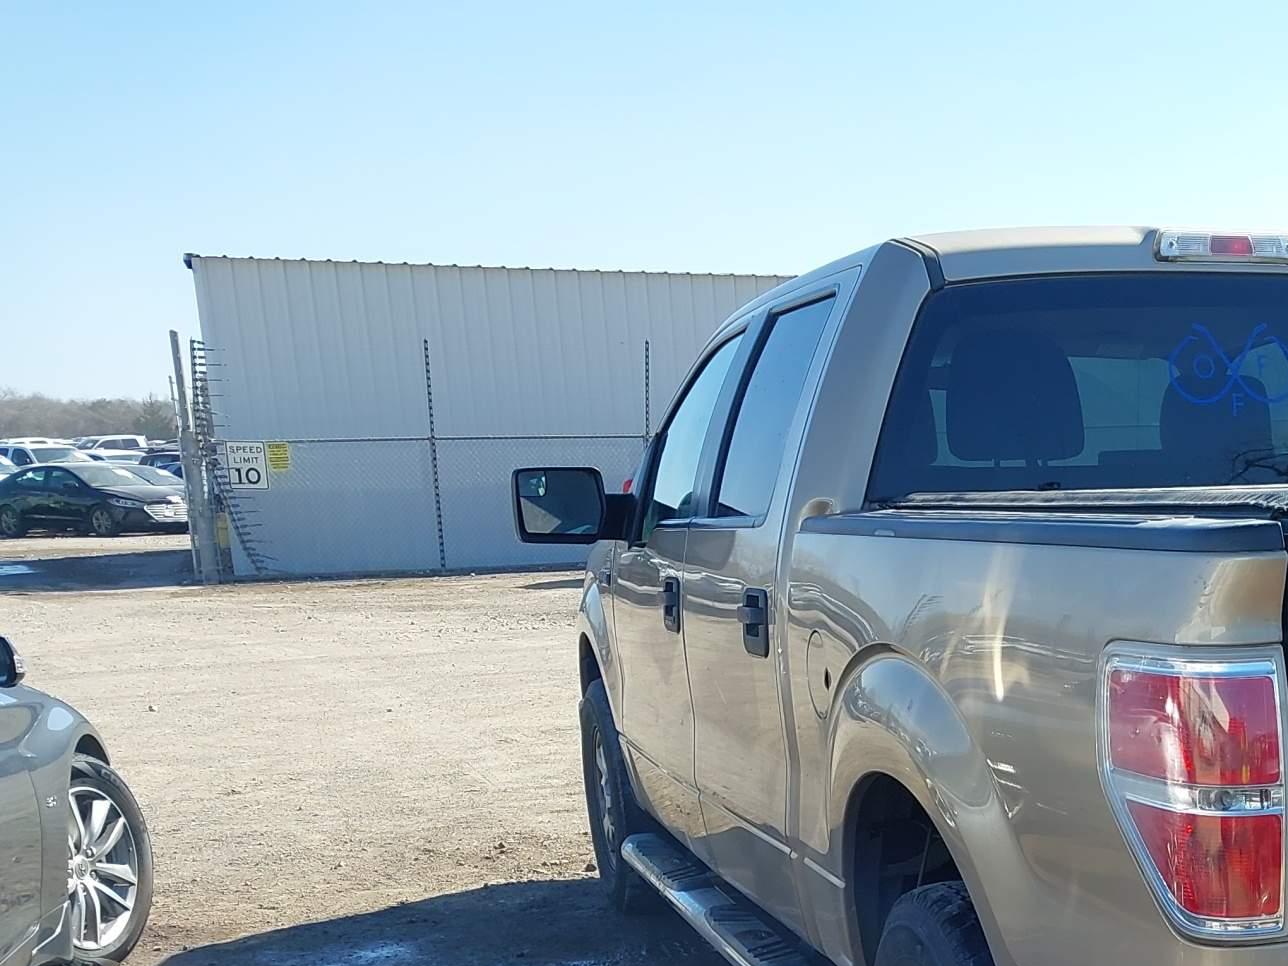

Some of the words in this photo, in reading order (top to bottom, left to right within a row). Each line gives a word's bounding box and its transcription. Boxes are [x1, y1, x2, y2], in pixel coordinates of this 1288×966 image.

[229, 445, 262, 454] SPEED
[233, 456, 259, 464] LIMIT
[235, 467, 261, 484] 10
